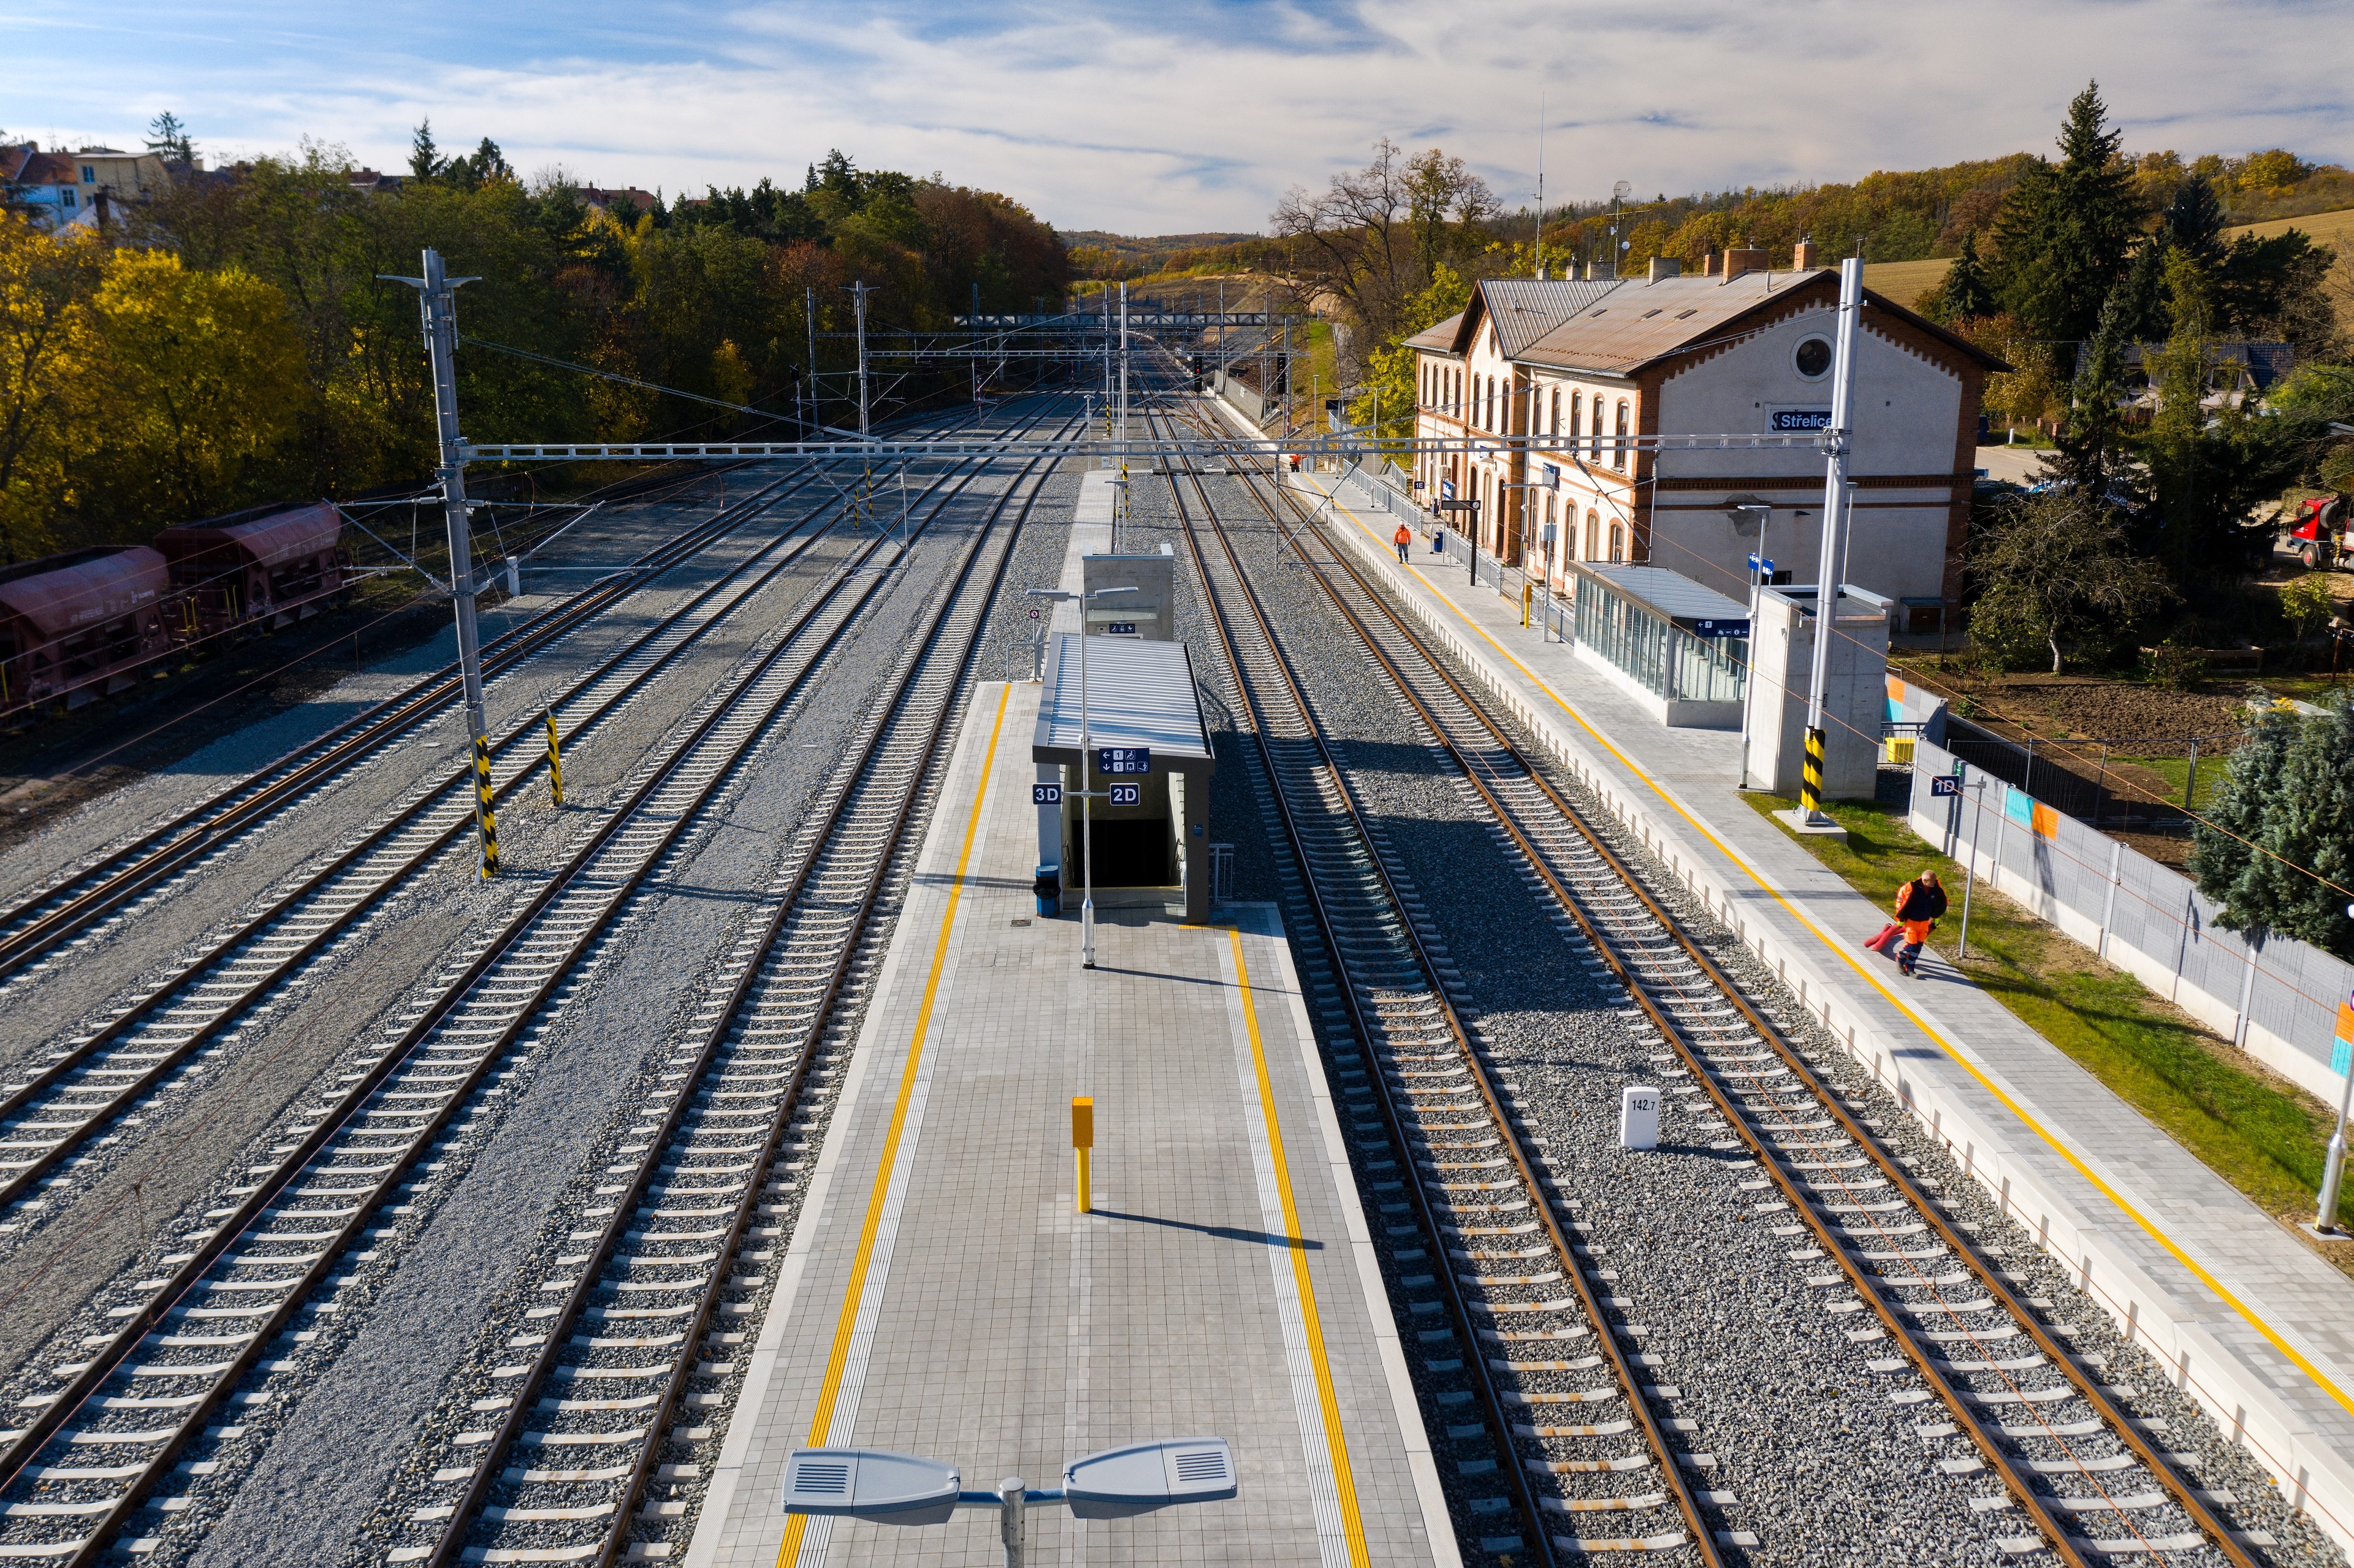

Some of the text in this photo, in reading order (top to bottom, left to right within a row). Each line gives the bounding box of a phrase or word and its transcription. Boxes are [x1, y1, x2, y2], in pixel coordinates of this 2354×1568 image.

[1781, 414, 1832, 427] Střelice
[1936, 780, 1955, 793] 1D
[1035, 788, 1059, 801] 3D
[1113, 788, 1137, 801] 2D
[1632, 1099, 1655, 1111] 142.7
